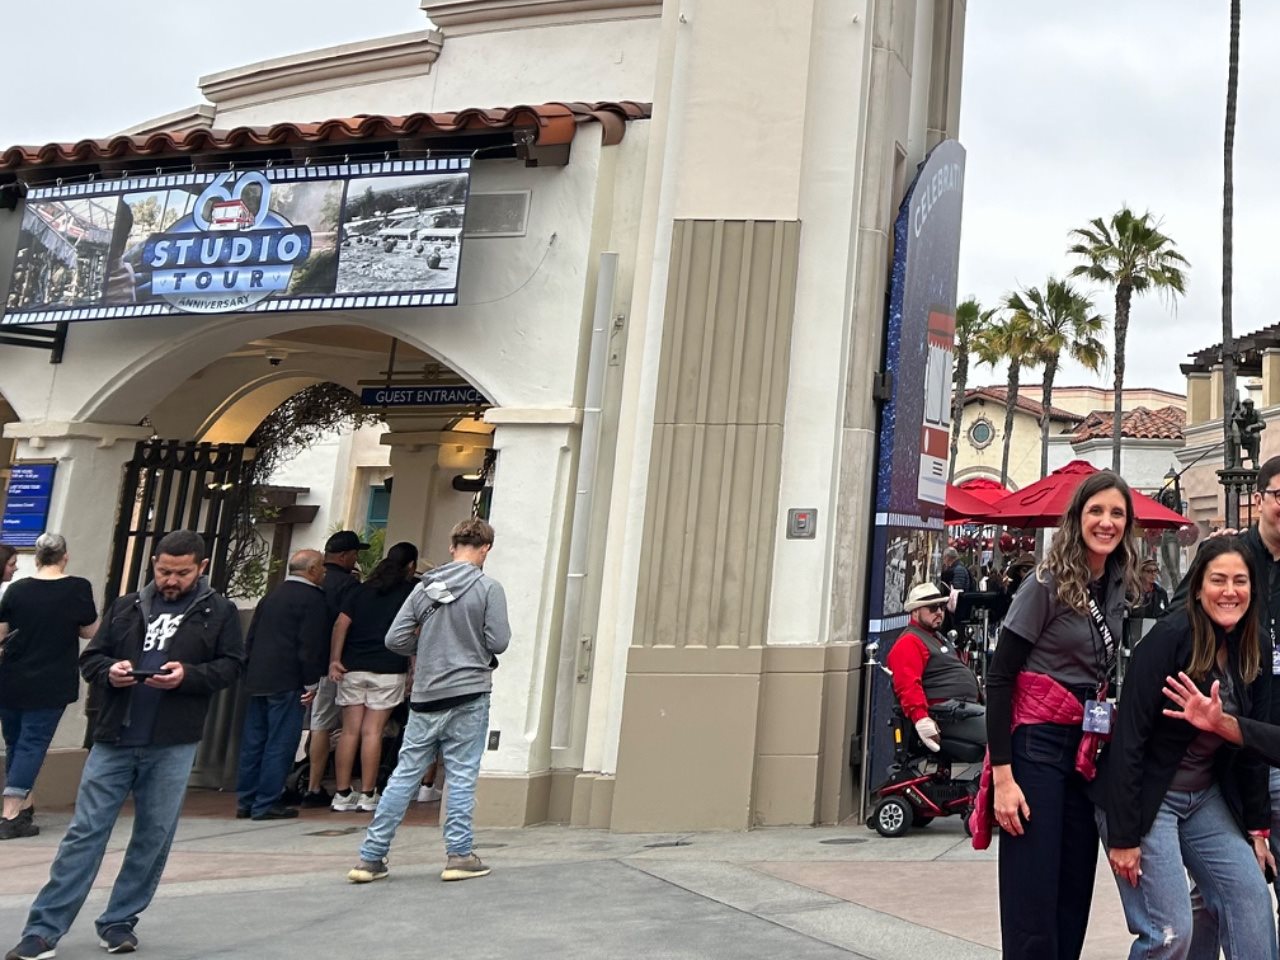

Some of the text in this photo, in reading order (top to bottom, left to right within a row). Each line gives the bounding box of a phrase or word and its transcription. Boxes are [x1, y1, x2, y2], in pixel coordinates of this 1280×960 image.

[193, 170, 272, 232] 60
[150, 233, 302, 268] STUDIO
[173, 269, 264, 291] TOUR
[178, 294, 250, 309] ANNIVERSARY
[375, 389, 481, 403] GUEST ENTRANCE
